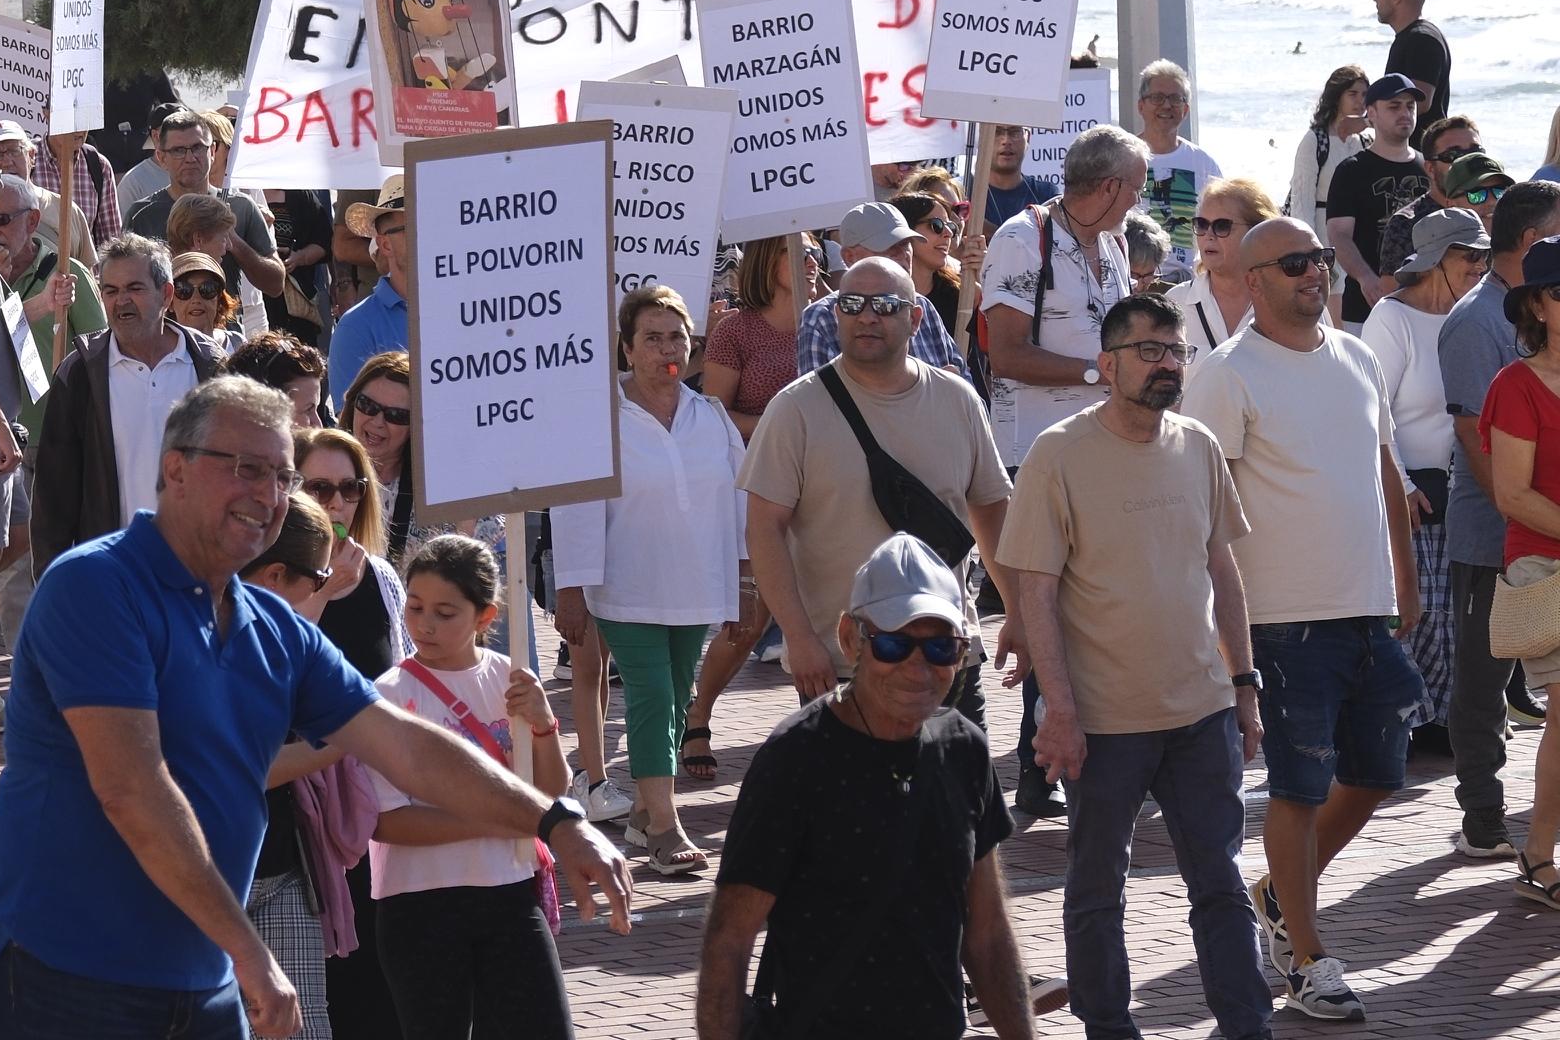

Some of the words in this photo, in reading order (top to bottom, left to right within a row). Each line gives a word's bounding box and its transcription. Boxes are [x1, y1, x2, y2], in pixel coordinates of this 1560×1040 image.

[63, 0, 92, 18] UNIDOS
[731, 12, 815, 43] BARRIO
[941, 12, 1009, 34] SOMOS
[1014, 17, 1057, 39] MÁS
[1, 36, 50, 59] BARRIO
[56, 34, 81, 51] SOMOS
[81, 31, 98, 50] MÁS
[713, 44, 841, 84] MARZAGÁN
[958, 50, 1018, 76] LPGC
[62, 68, 84, 89] LPGC
[738, 87, 824, 117] UNIDOS
[613, 122, 694, 145] BARRIO
[730, 128, 796, 154] OMOS
[802, 119, 848, 143] MÁS
[1032, 147, 1065, 162] UNID
[628, 161, 694, 183] RISCO
[750, 162, 815, 193] LPGC
[459, 189, 558, 226] BARRIO
[614, 198, 685, 220] NIDOS
[435, 255, 459, 278] EL
[466, 237, 584, 276] POLVORIN
[653, 234, 700, 257] MÁS
[460, 289, 562, 327] UNIDOS
[429, 346, 527, 385] SOMOS
[535, 333, 594, 370] MÁS
[475, 397, 534, 428] LPGC
